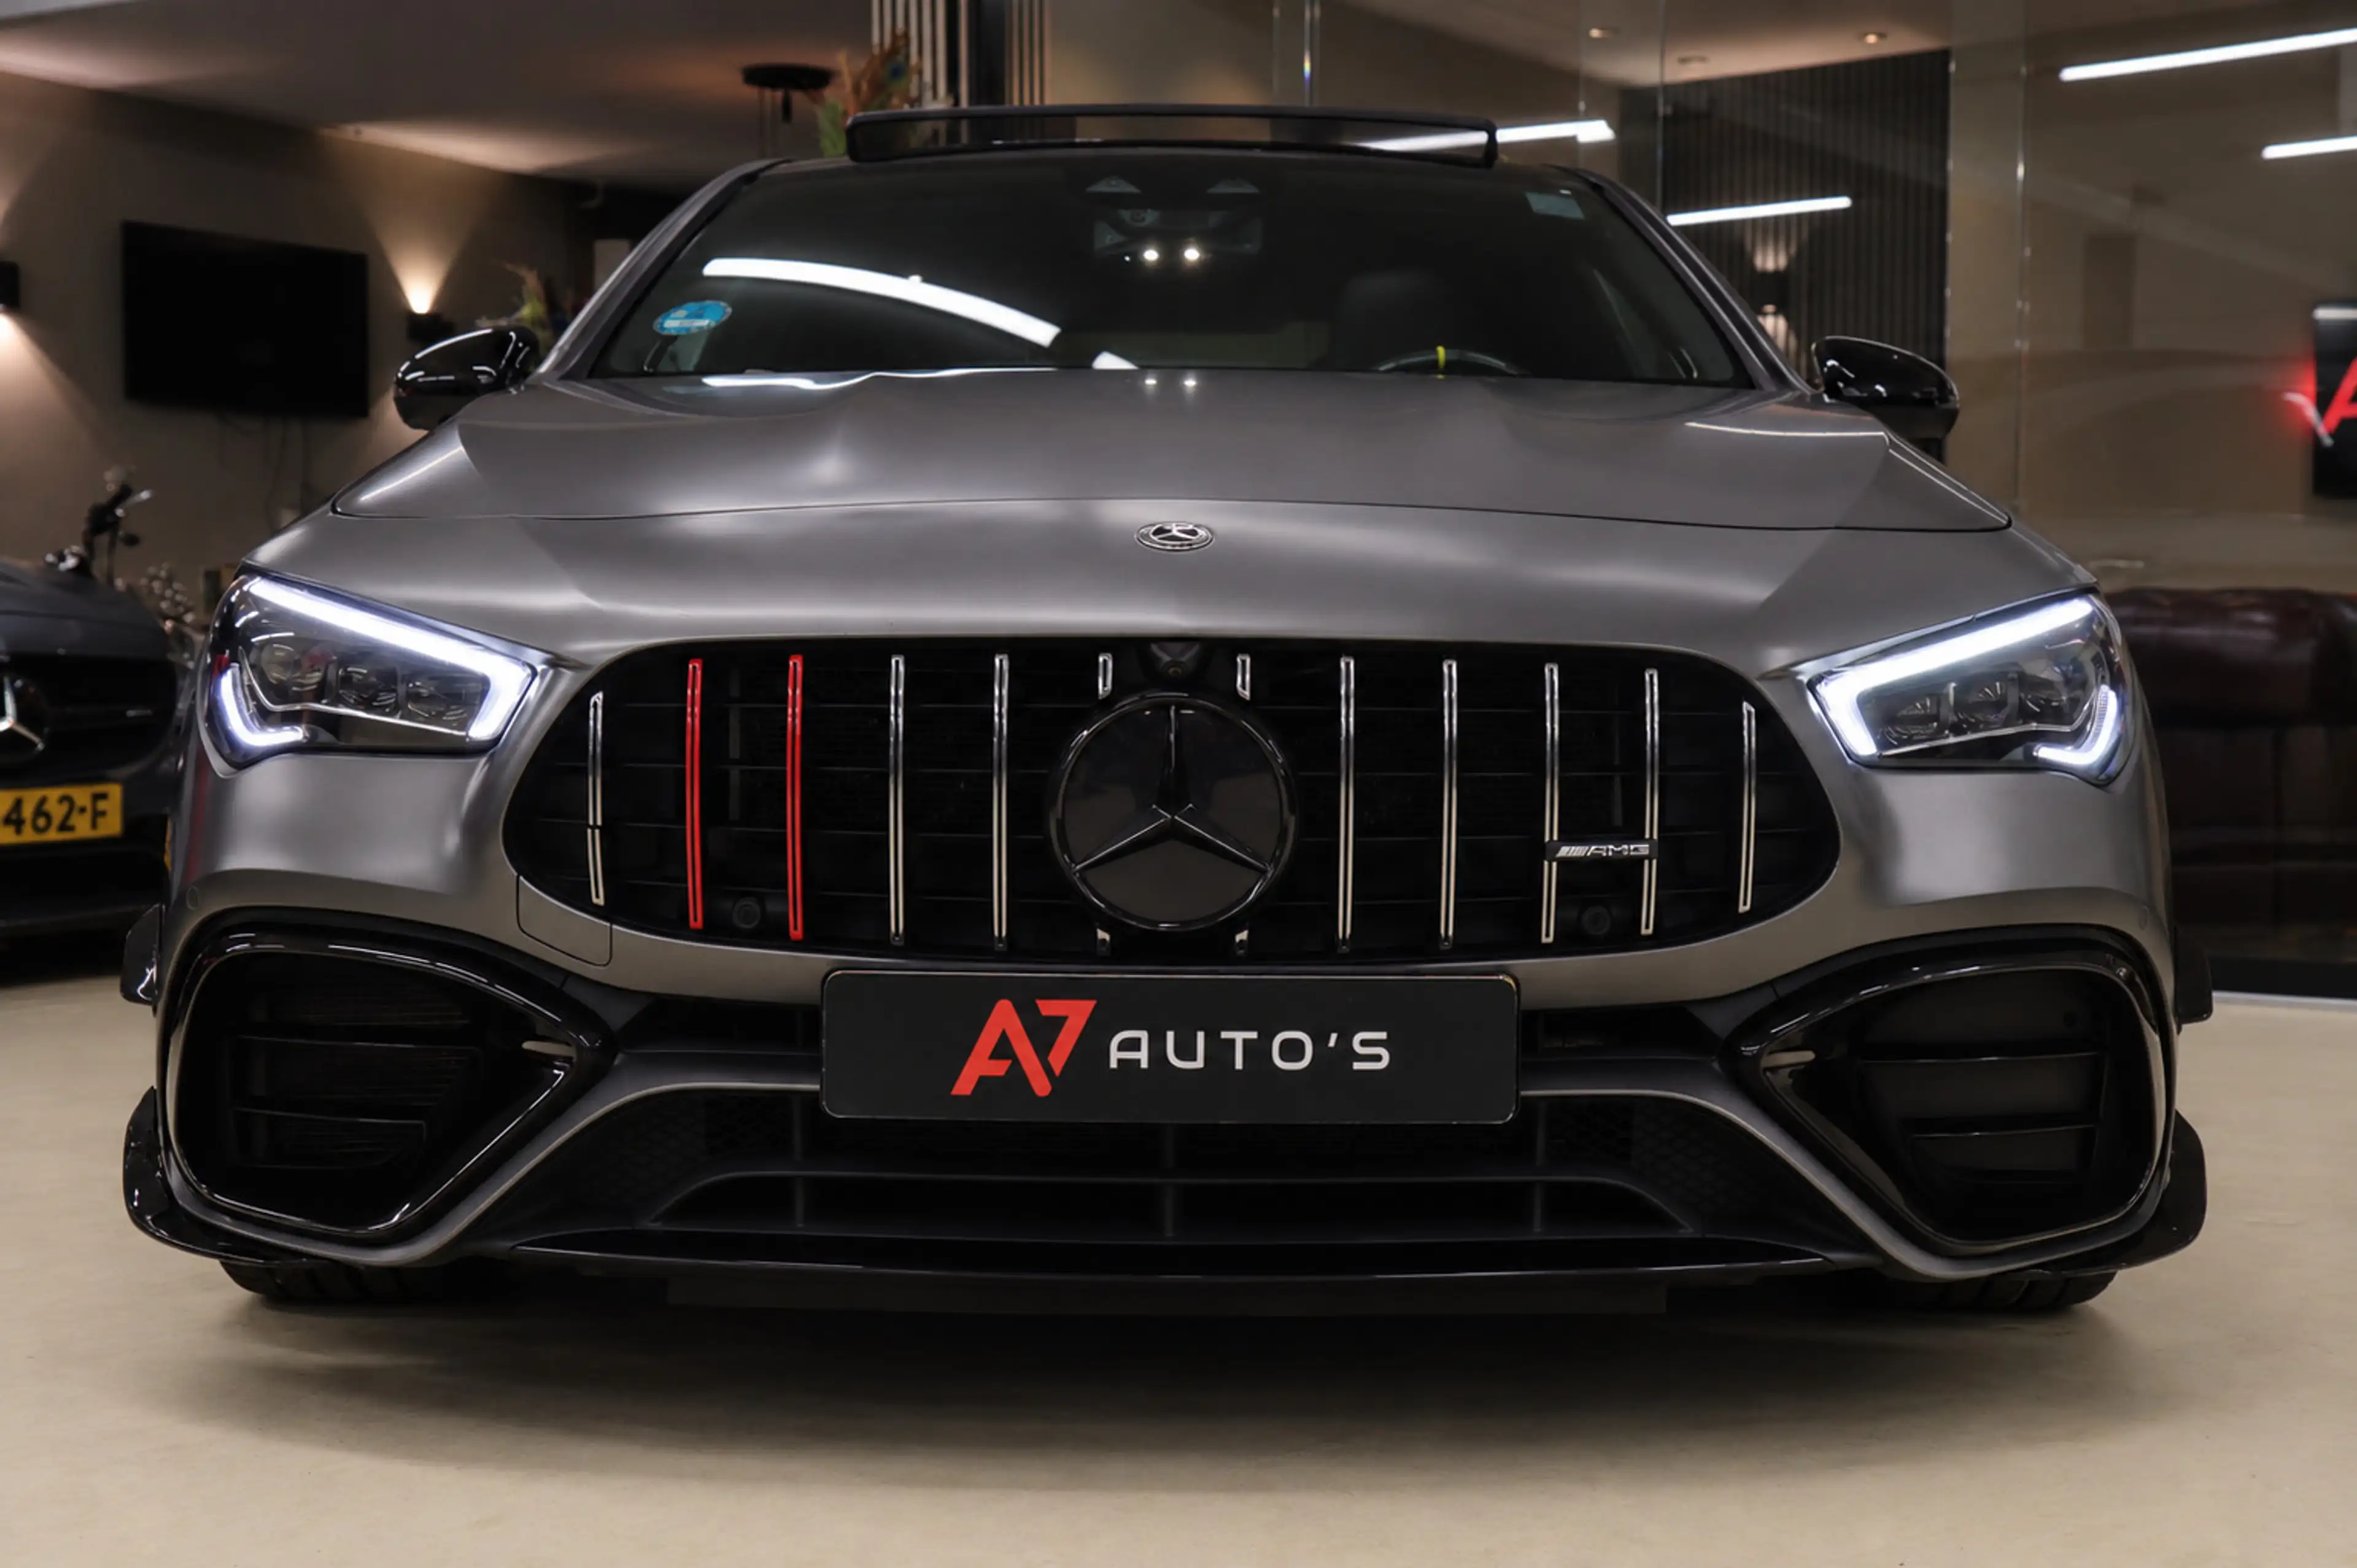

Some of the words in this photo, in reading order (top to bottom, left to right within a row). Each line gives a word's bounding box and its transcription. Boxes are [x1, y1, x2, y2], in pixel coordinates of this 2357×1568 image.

[1587, 844, 1650, 857] AMG
[951, 998, 1097, 1097] A7
[1109, 1029, 1390, 1071] AUTO'S
